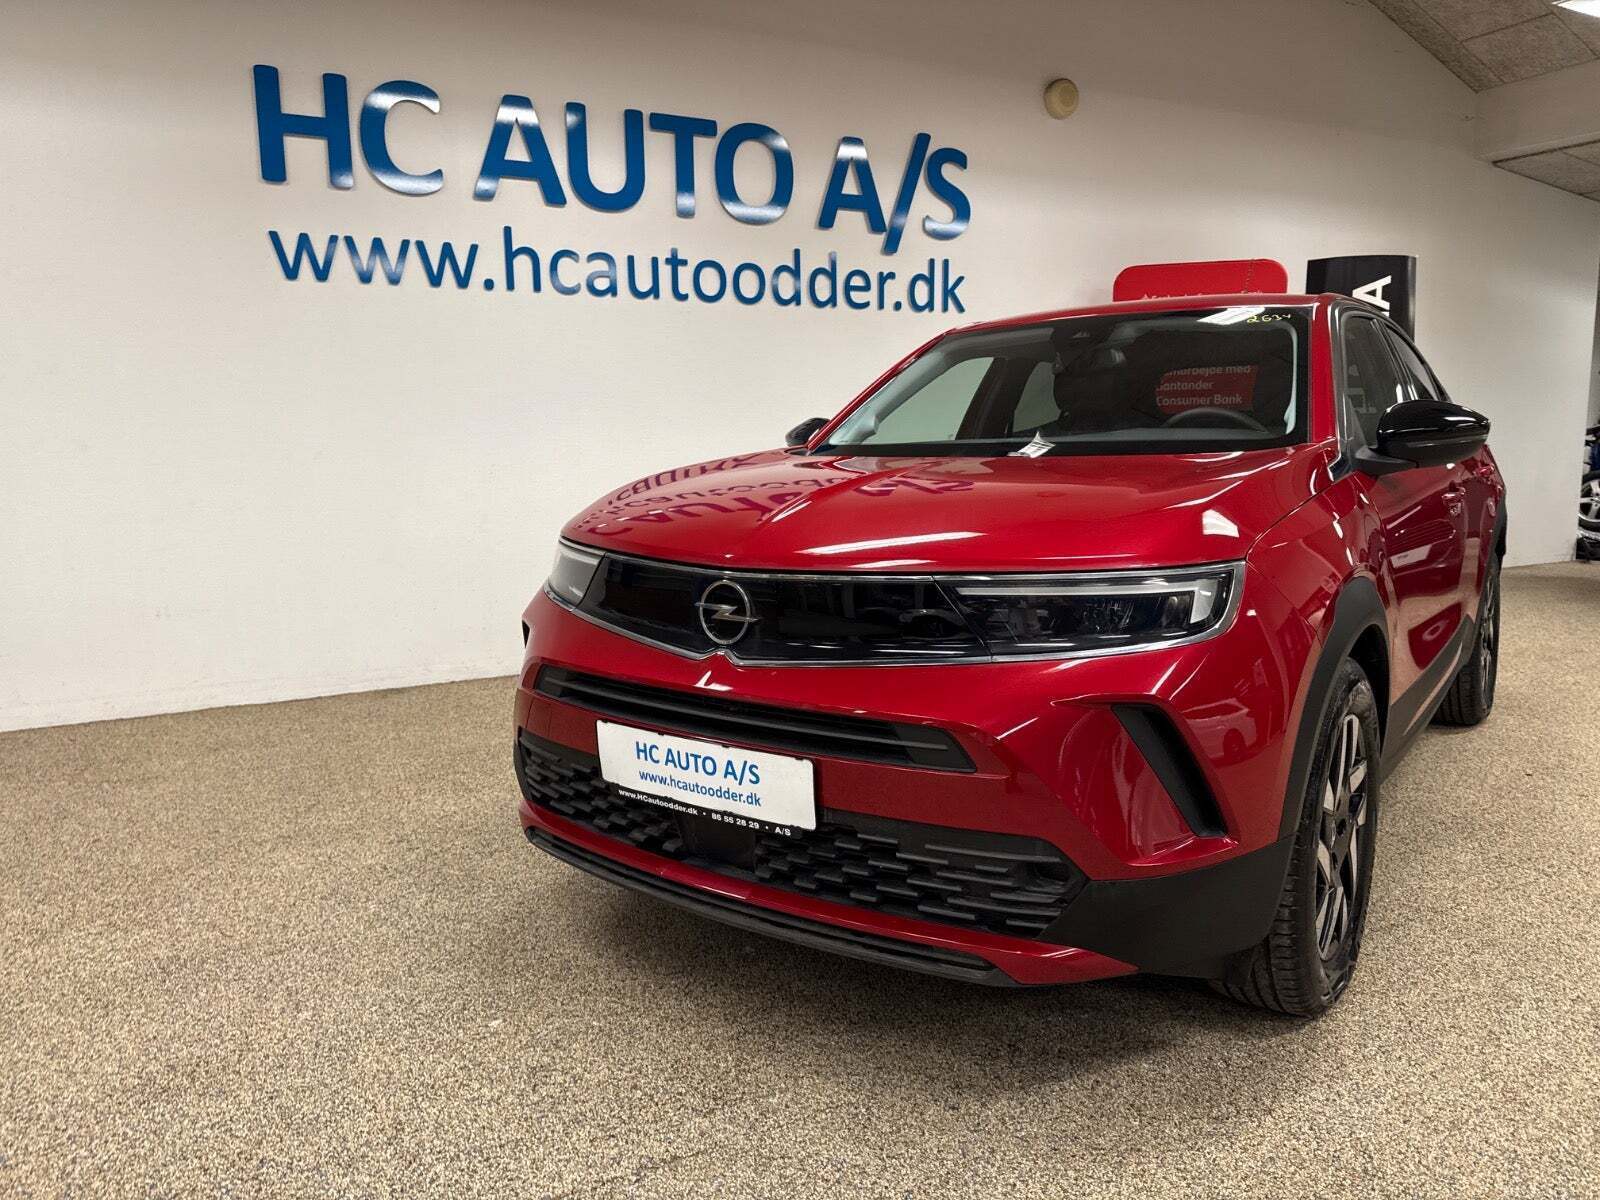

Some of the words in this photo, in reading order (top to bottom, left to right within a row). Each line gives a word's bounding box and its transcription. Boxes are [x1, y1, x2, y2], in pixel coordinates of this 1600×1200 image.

[252, 64, 445, 195] HC
[473, 95, 794, 222] AUTO
[818, 132, 972, 256] A/S
[268, 226, 966, 314] www.hcautoodder.dk
[1214, 393, 1243, 405] Bank
[635, 741, 660, 765] HC
[664, 747, 718, 777] AUTO
[723, 759, 761, 786] A/S
[638, 769, 762, 807] www.hcautoodder.dk
[618, 788, 698, 816] www.HCautoodder.dk
[774, 826, 792, 836] A/S
